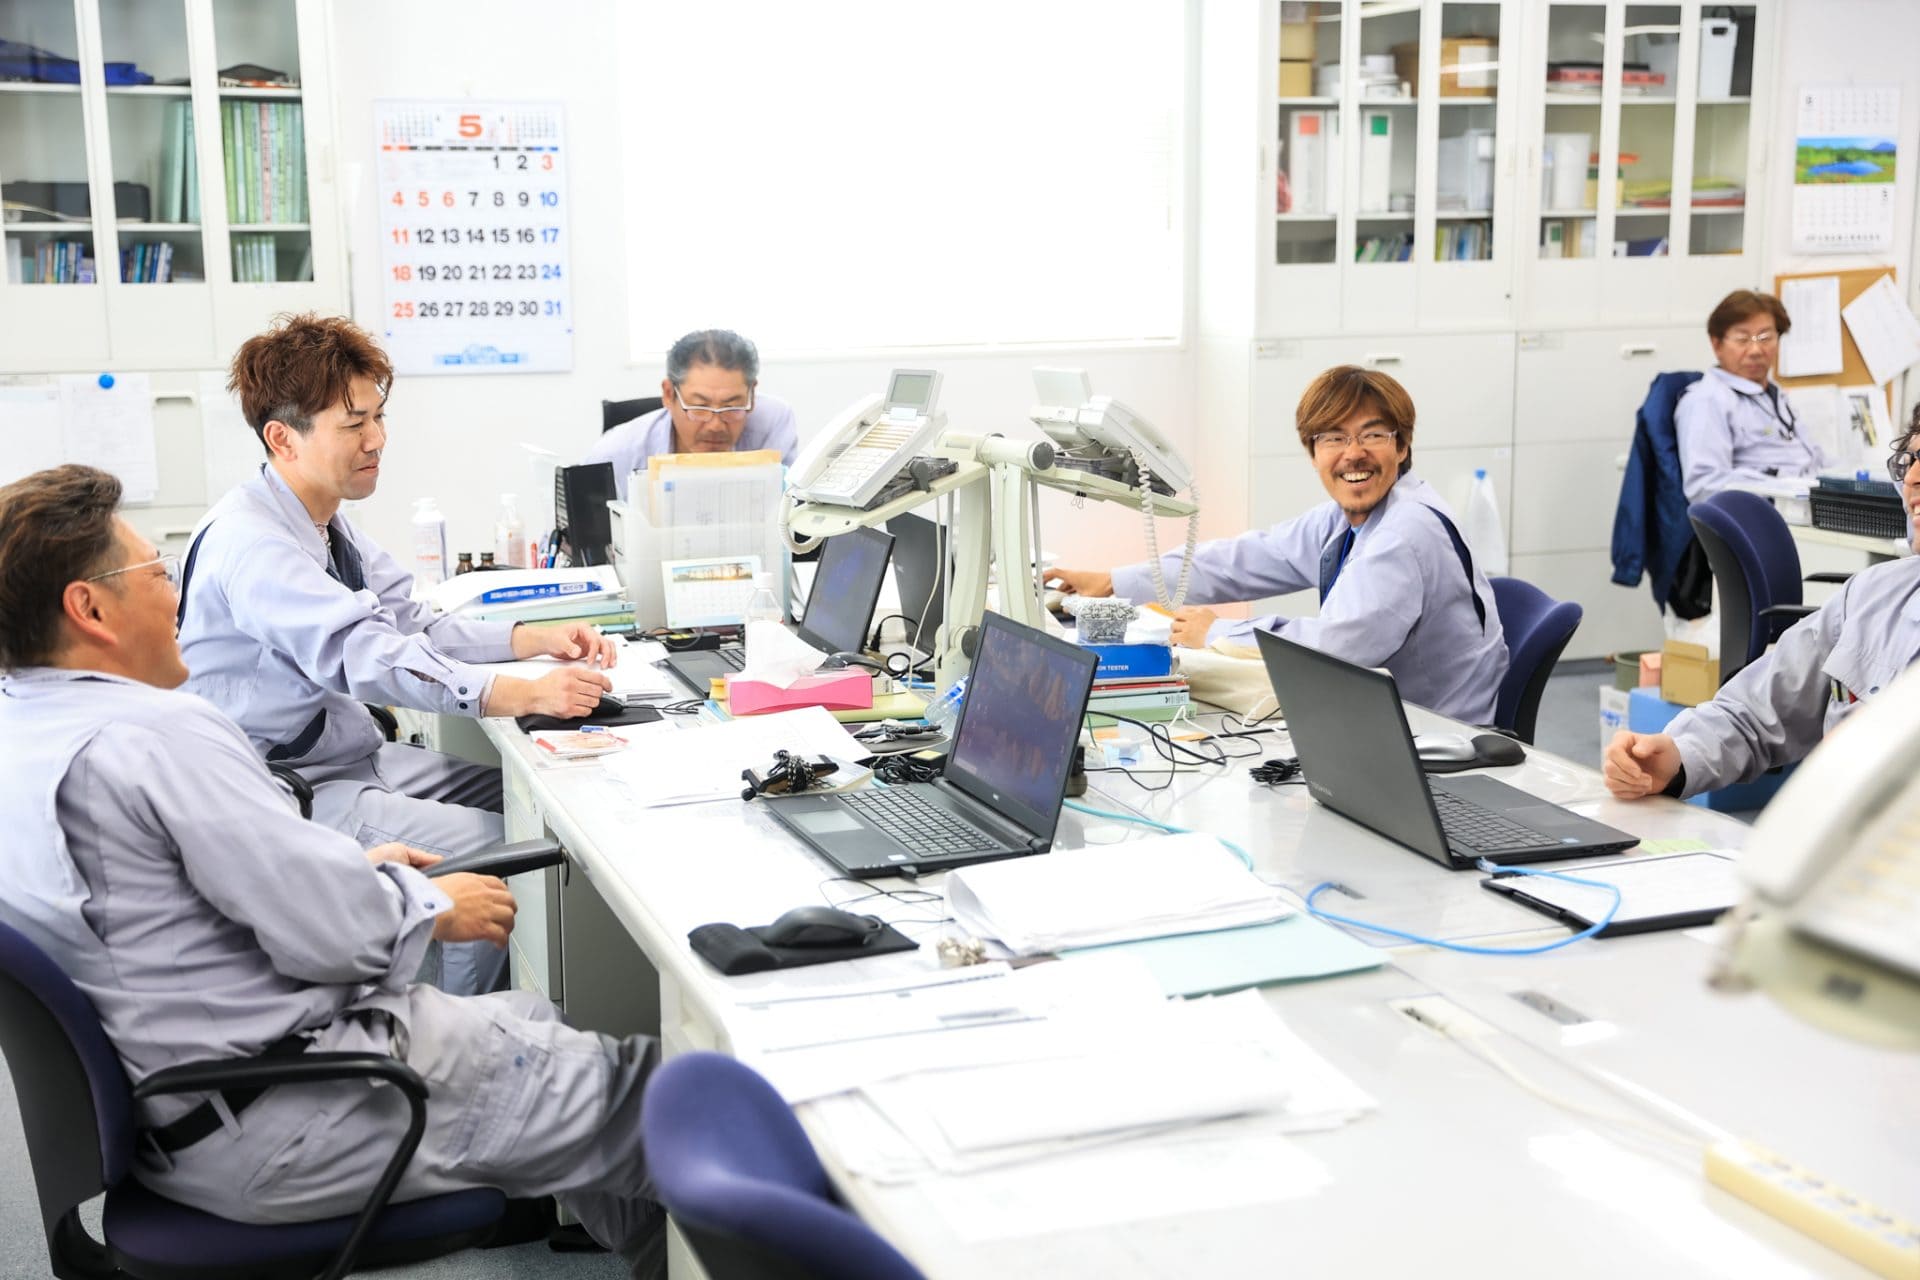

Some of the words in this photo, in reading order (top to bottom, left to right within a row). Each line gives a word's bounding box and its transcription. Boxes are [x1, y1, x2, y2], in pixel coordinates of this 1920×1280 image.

[458, 115, 483, 138] 5
[493, 155, 500, 169] 1
[517, 155, 528, 169] 2
[542, 155, 553, 170] 3
[392, 191, 404, 206] 4
[418, 191, 430, 208] 5
[442, 191, 455, 208] 6
[468, 191, 479, 207] 7
[493, 191, 505, 208] 8
[517, 191, 530, 207] 9
[539, 191, 559, 207] 10
[392, 228, 409, 244] 11
[416, 228, 435, 244] 12
[441, 228, 460, 244] 13
[466, 228, 485, 243] 14
[491, 228, 510, 244] 15
[516, 228, 535, 244] 16
[541, 227, 560, 243] 17
[392, 265, 412, 281] 18
[417, 265, 437, 281] 19
[442, 265, 463, 281] 20
[469, 264, 486, 281] 21
[492, 264, 512, 280] 22
[517, 264, 537, 280] 23
[542, 264, 562, 280] 24
[393, 302, 414, 319] 25
[419, 302, 439, 318] 26
[444, 301, 464, 317] 27
[469, 301, 489, 317] 28
[494, 300, 514, 317] 29
[519, 300, 539, 317] 30
[544, 300, 561, 316] 31
